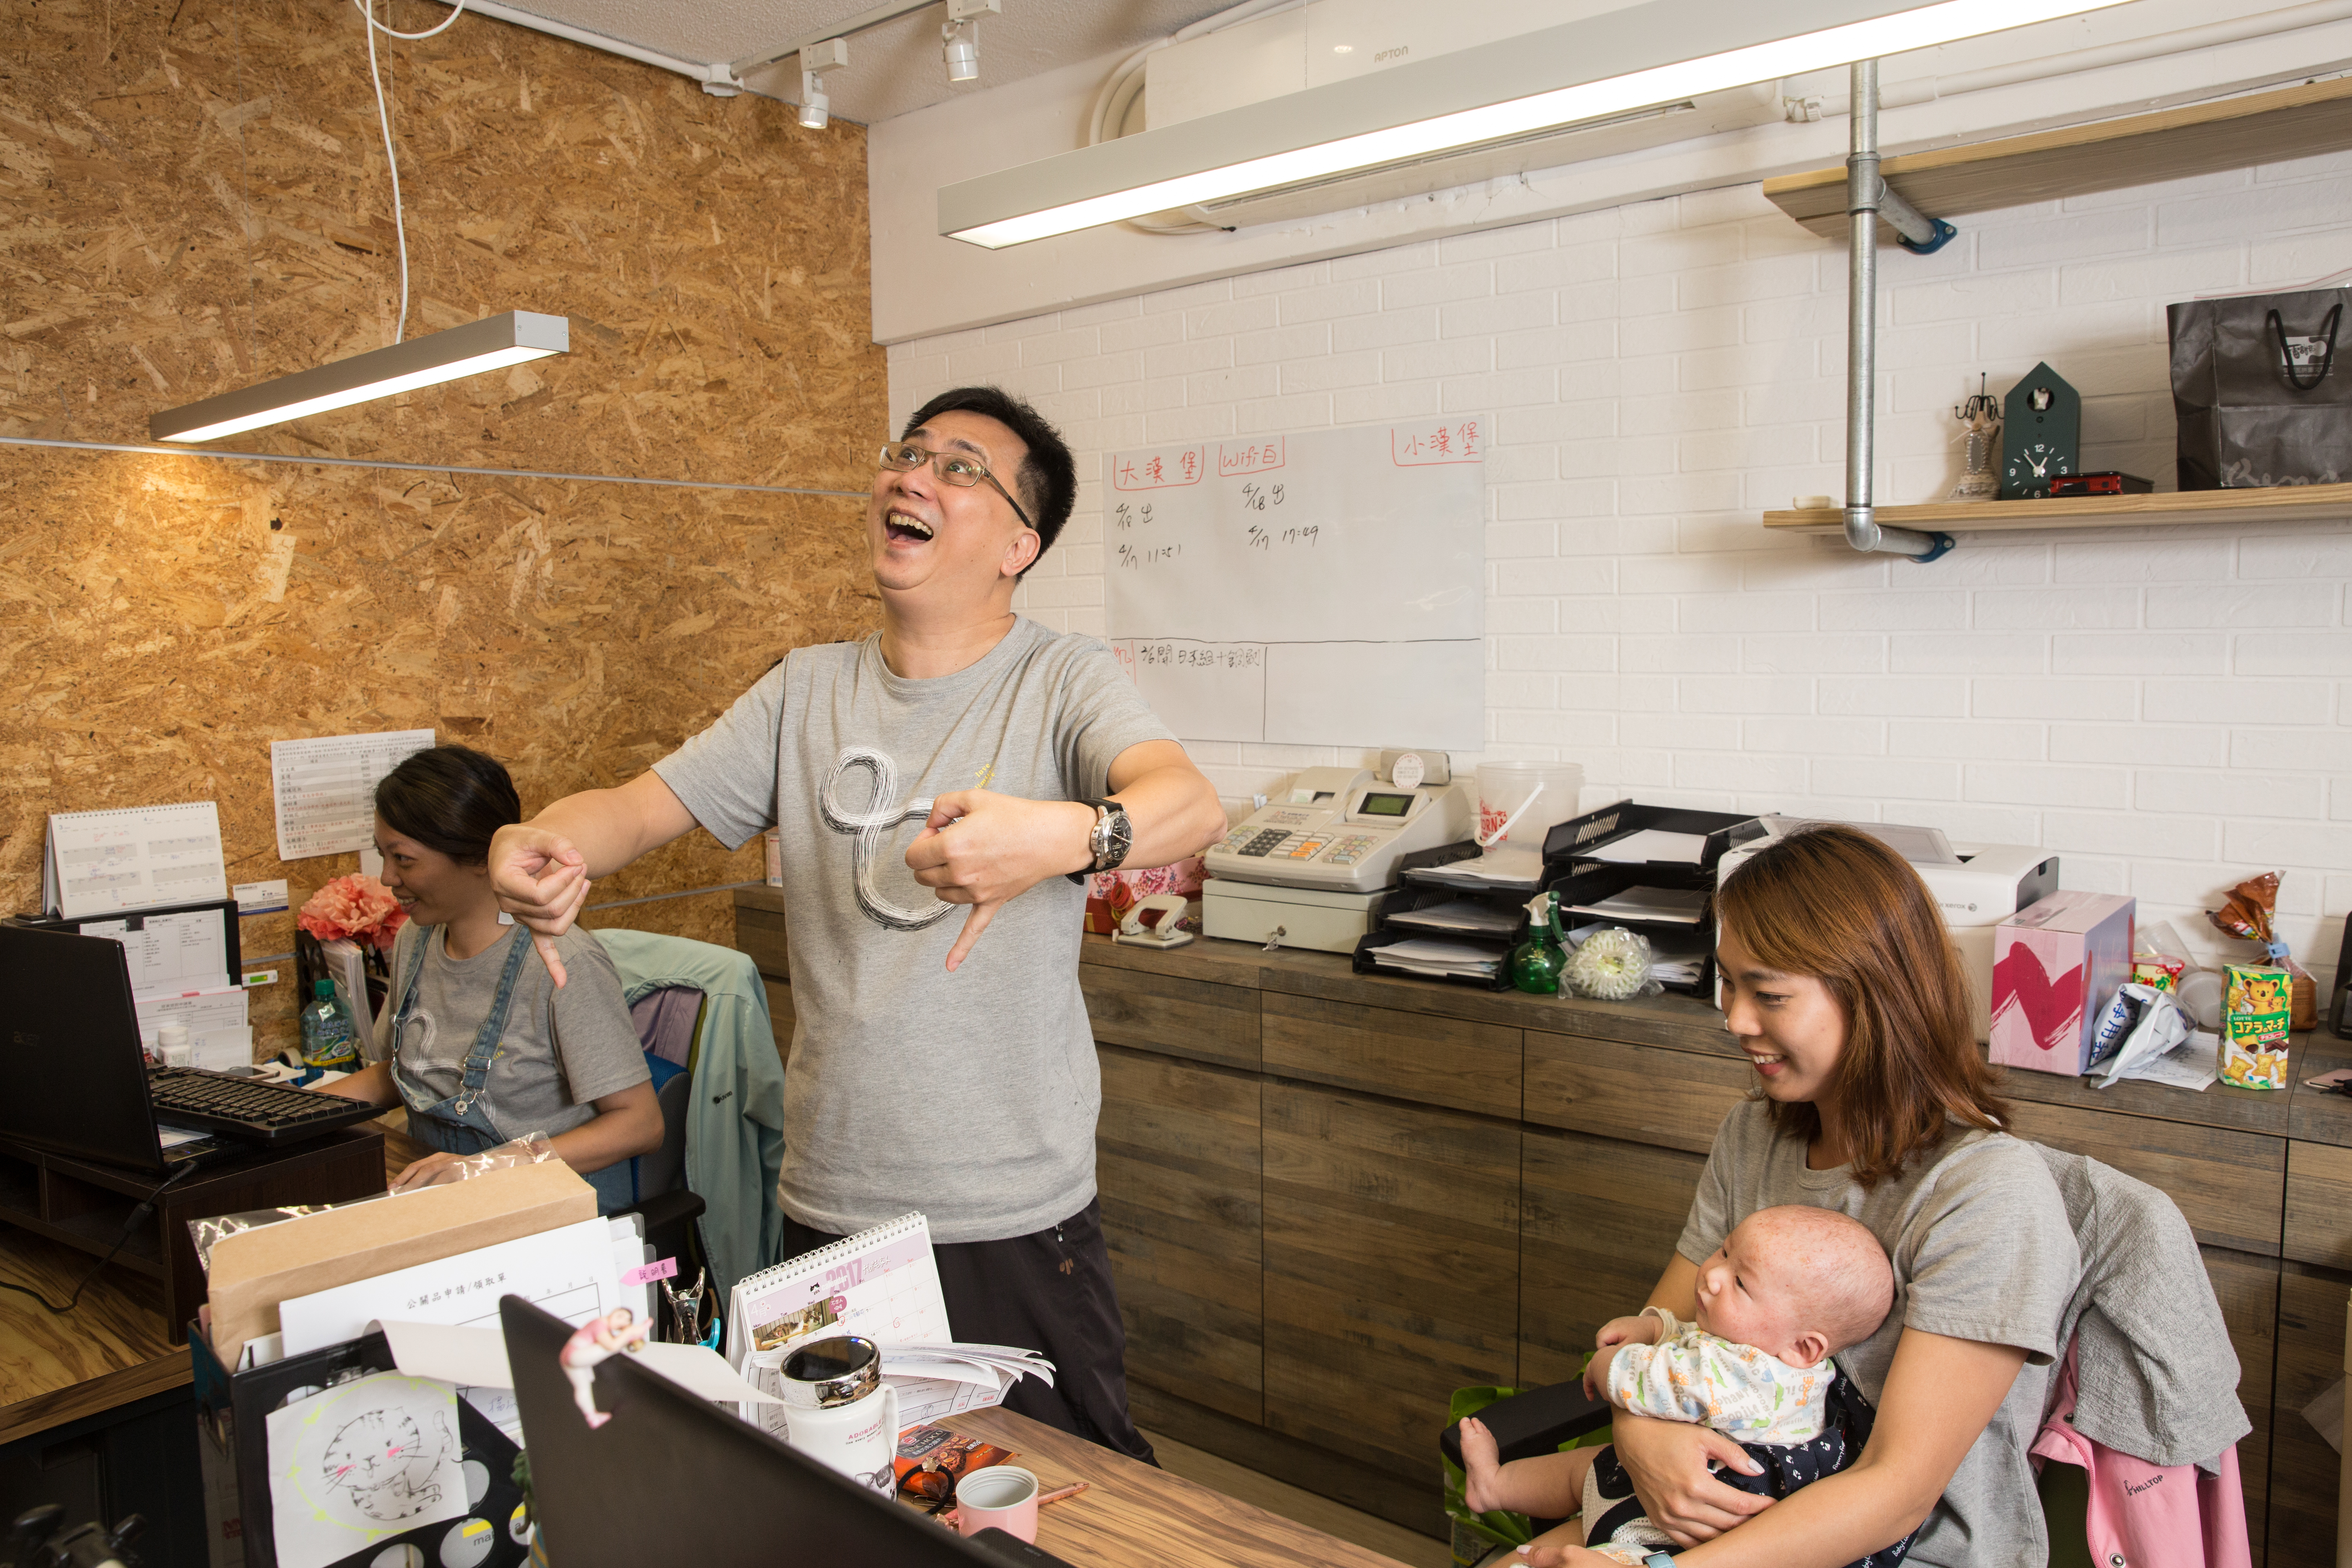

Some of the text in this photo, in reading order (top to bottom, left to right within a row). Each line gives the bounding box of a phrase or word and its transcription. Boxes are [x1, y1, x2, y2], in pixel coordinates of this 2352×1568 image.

[1374, 46, 1408, 63] APTON
[2034, 444, 2045, 452] 12
[2009, 468, 2016, 477] 9
[2060, 466, 2068, 474] 3
[2034, 490, 2041, 499] 6
[975, 763, 990, 777] love
[1481, 816, 1498, 833] ORN
[407, 1272, 507, 1309] 公關品申請/領取單
[751, 1303, 767, 1319] 4月
[844, 1419, 881, 1440] ADORABLE
[897, 1430, 943, 1454] CRUNCHOCO
[2133, 1475, 2163, 1494] HILLTOP
